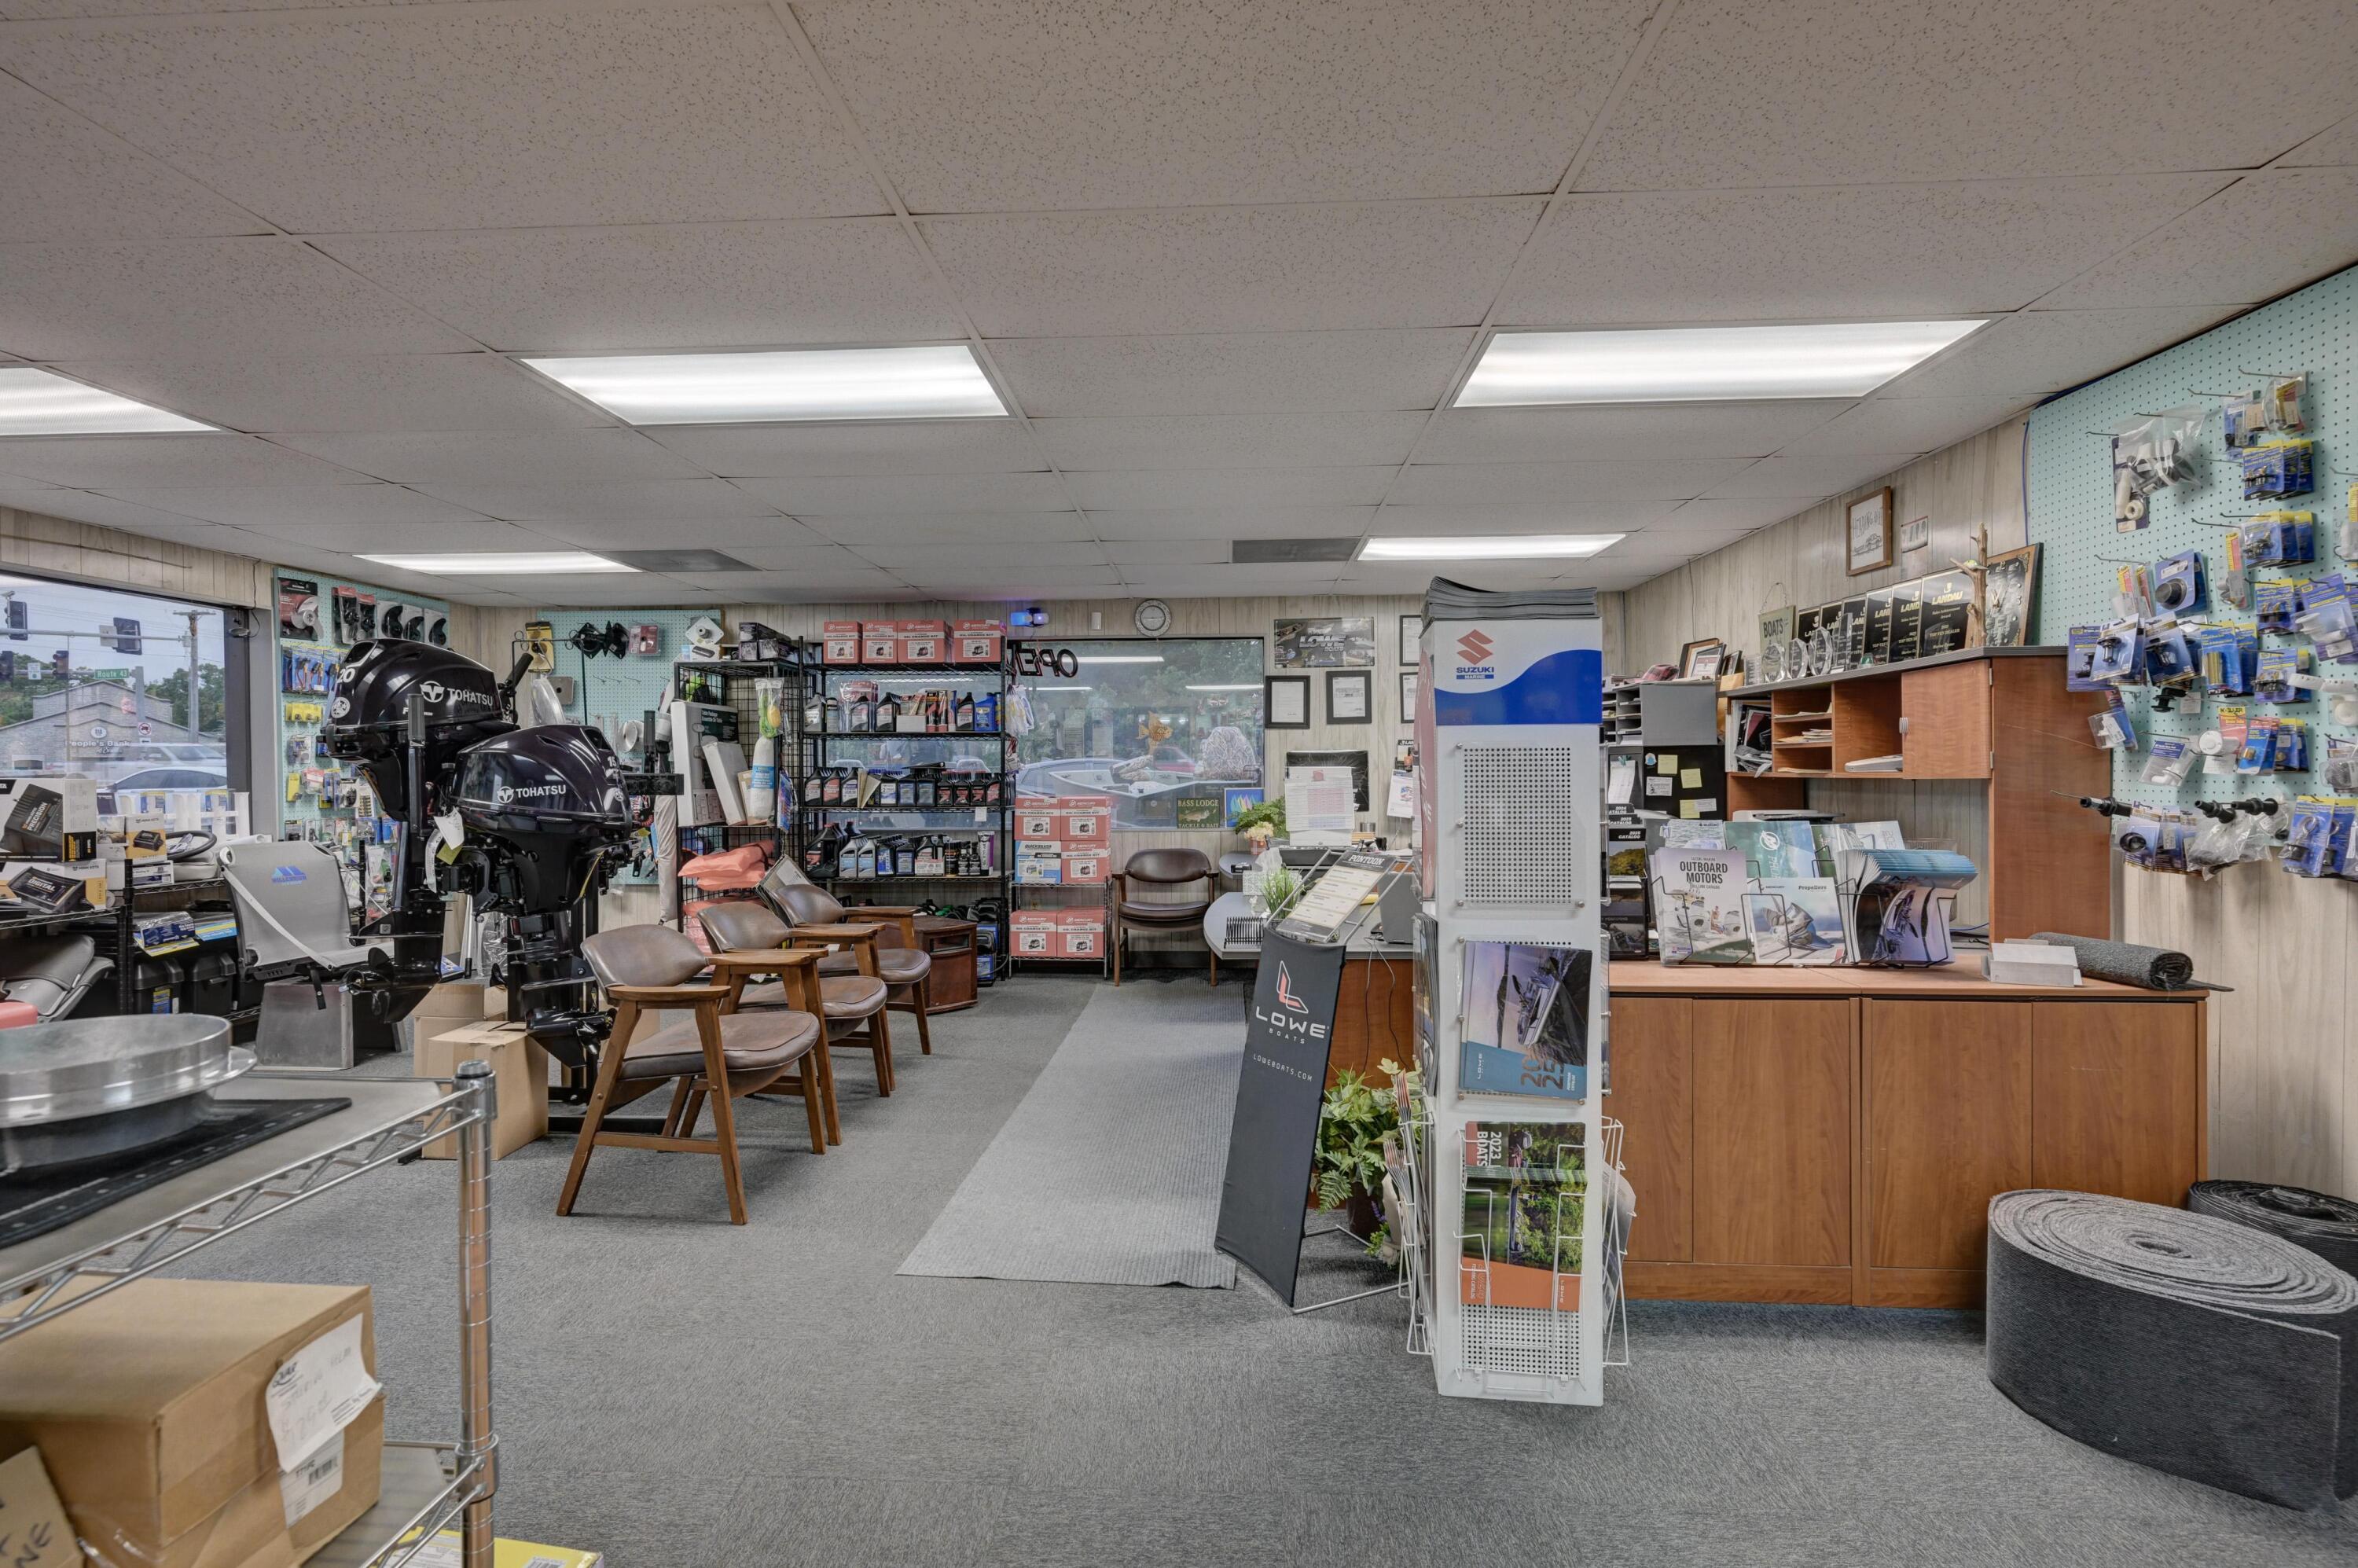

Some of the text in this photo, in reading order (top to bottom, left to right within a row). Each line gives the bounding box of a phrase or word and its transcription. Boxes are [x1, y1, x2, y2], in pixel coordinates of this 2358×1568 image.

[1931, 590, 1963, 605] LANDAU
[1874, 608, 1890, 619] LAN
[1901, 601, 1919, 612] LAND
[1763, 618, 1783, 638] BOATS
[1298, 635, 1347, 648] LOWE
[337, 668, 355, 683] 20
[446, 688, 494, 707] TOHATSU
[608, 756, 617, 767] 15
[516, 784, 567, 799] TOHATSU
[27, 802, 48, 831] PRECISION
[1348, 854, 1385, 865] PONTOON
[1680, 861, 1728, 873] OUTBOARD
[28, 879, 56, 891] DIGITAL
[1686, 872, 1723, 884] MOTORS
[1255, 1006, 1326, 1038] LOWE
[1269, 1028, 1305, 1044] BOATS
[1253, 1052, 1313, 1082] LOWEBOATS.COM
[1477, 1131, 1489, 1167] BOATS
[1490, 1131, 1502, 1159] 2023
